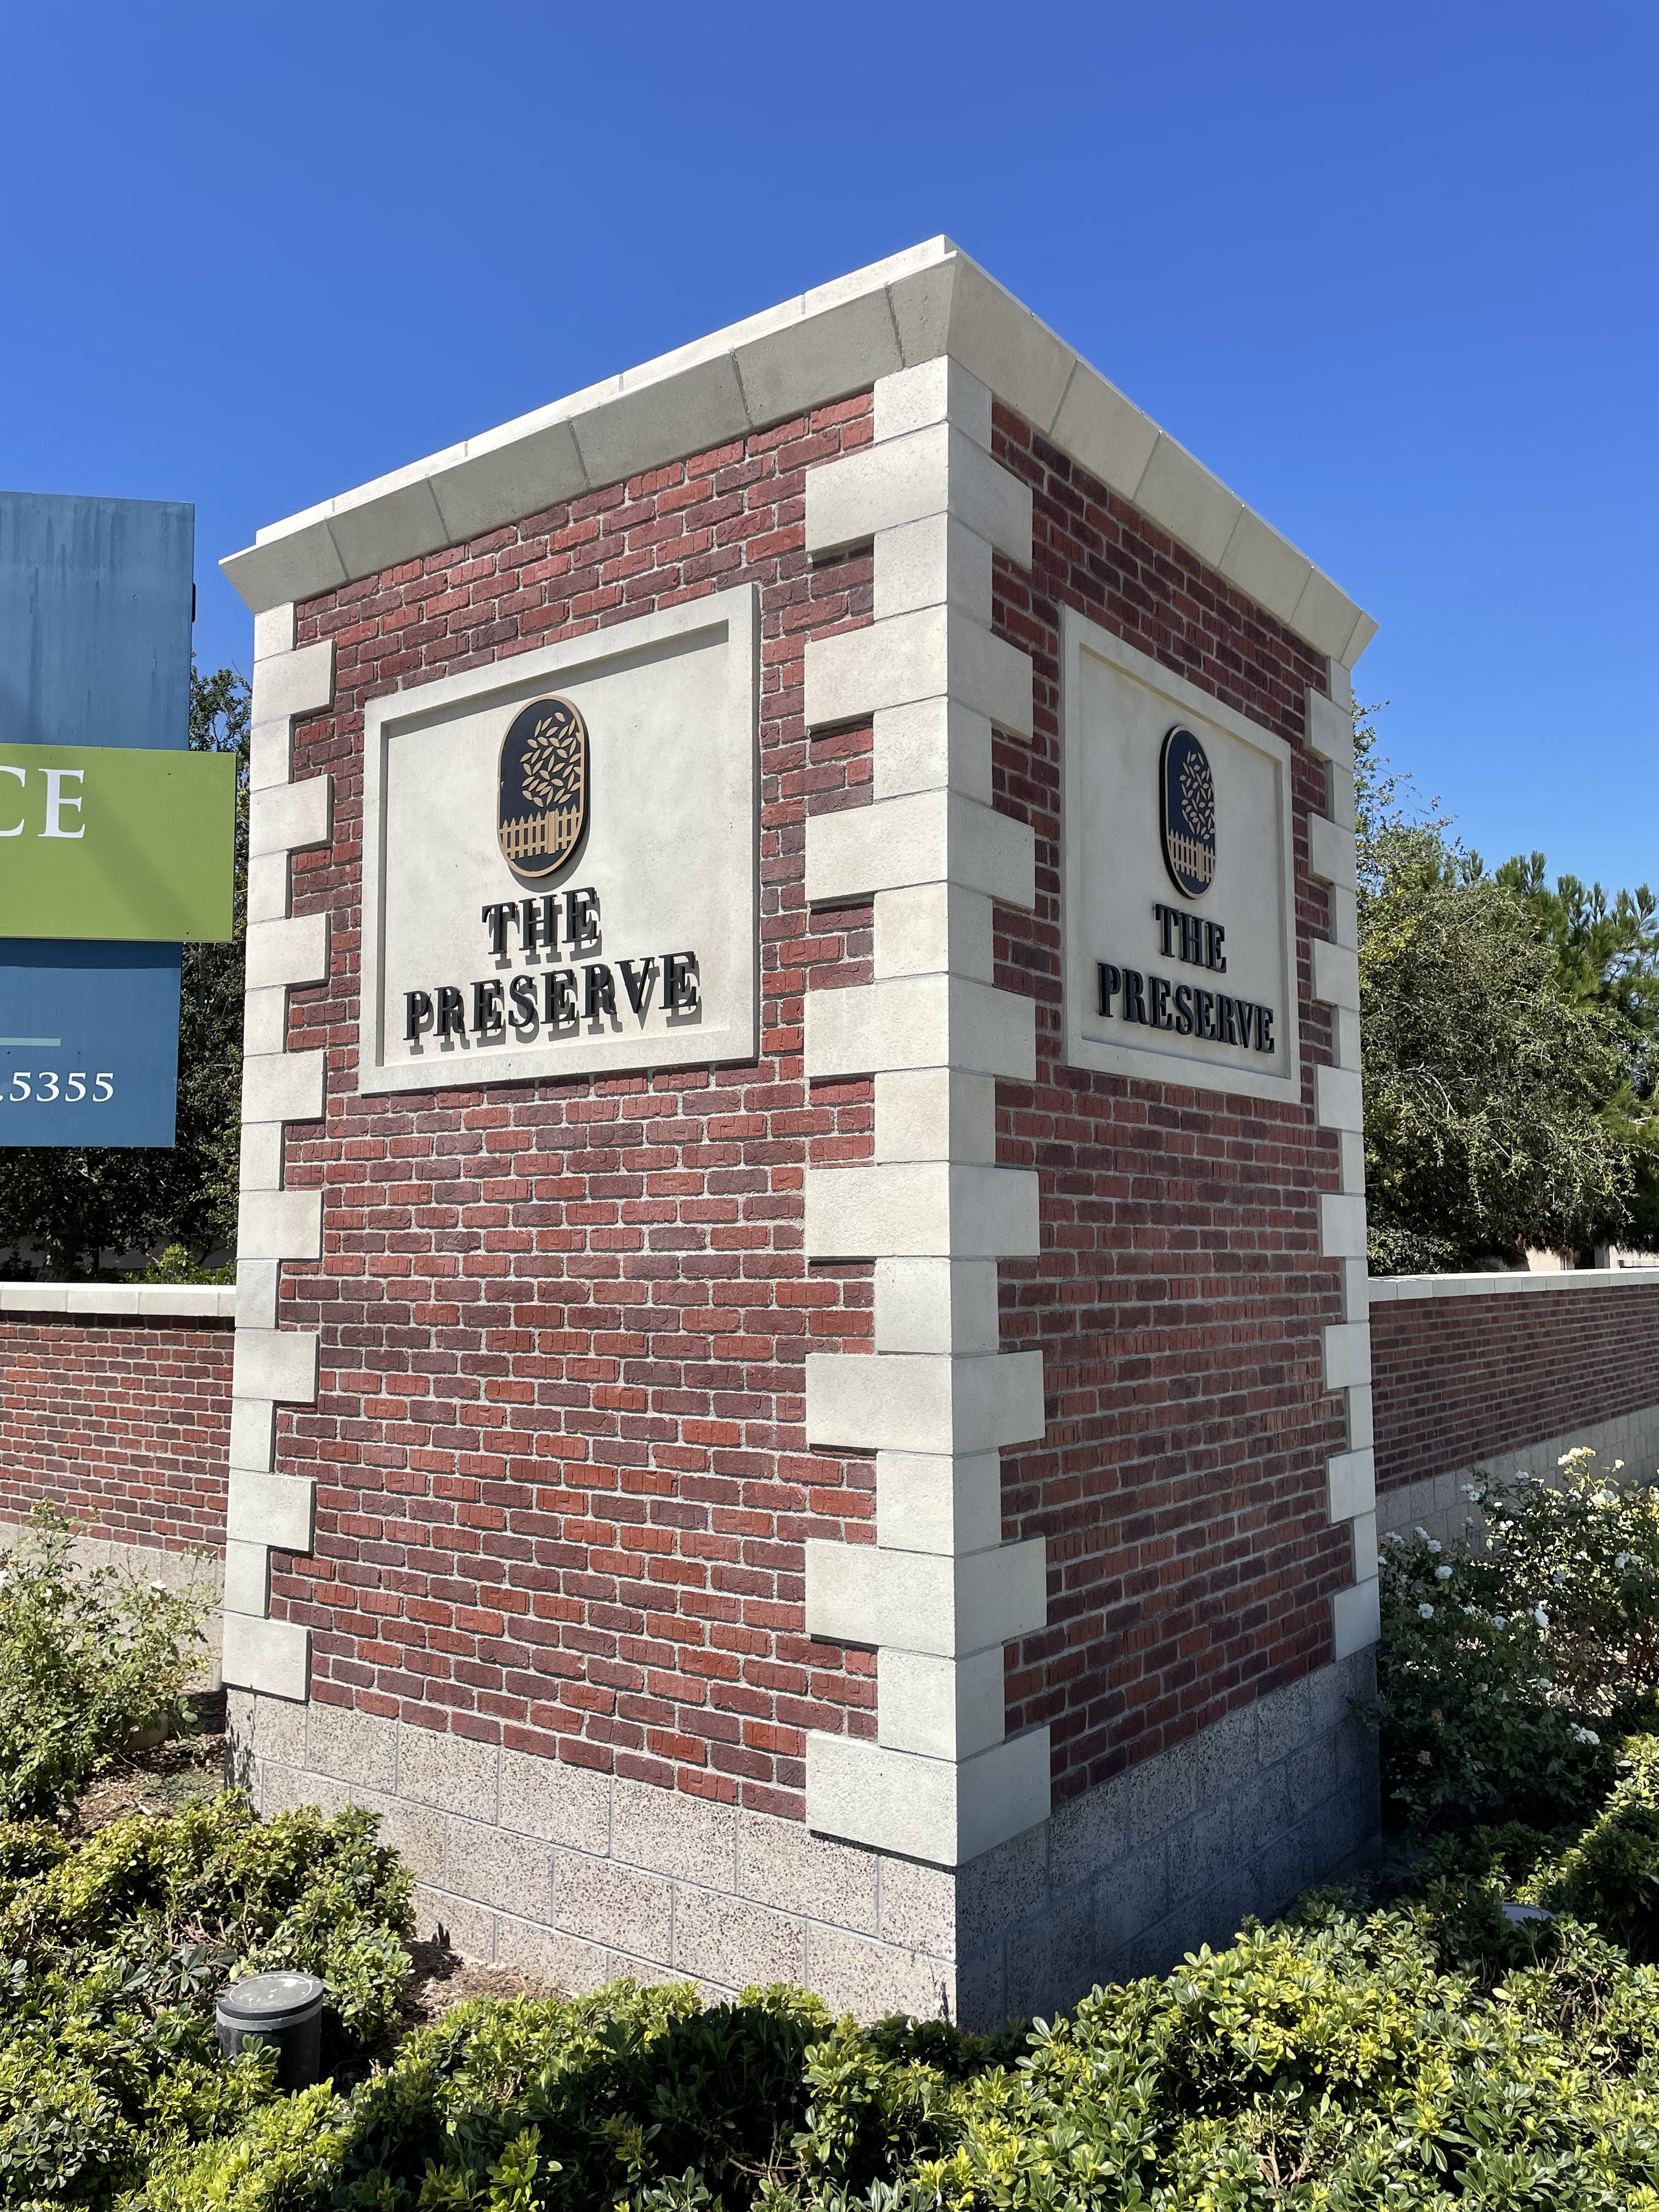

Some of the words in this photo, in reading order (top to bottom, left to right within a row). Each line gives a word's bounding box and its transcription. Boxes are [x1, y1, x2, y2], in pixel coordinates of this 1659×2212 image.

[482, 887, 599, 955] THE
[1155, 904, 1227, 973] THE
[403, 951, 701, 1041] PRESERVE
[1098, 963, 1274, 1053] PRESERVE
